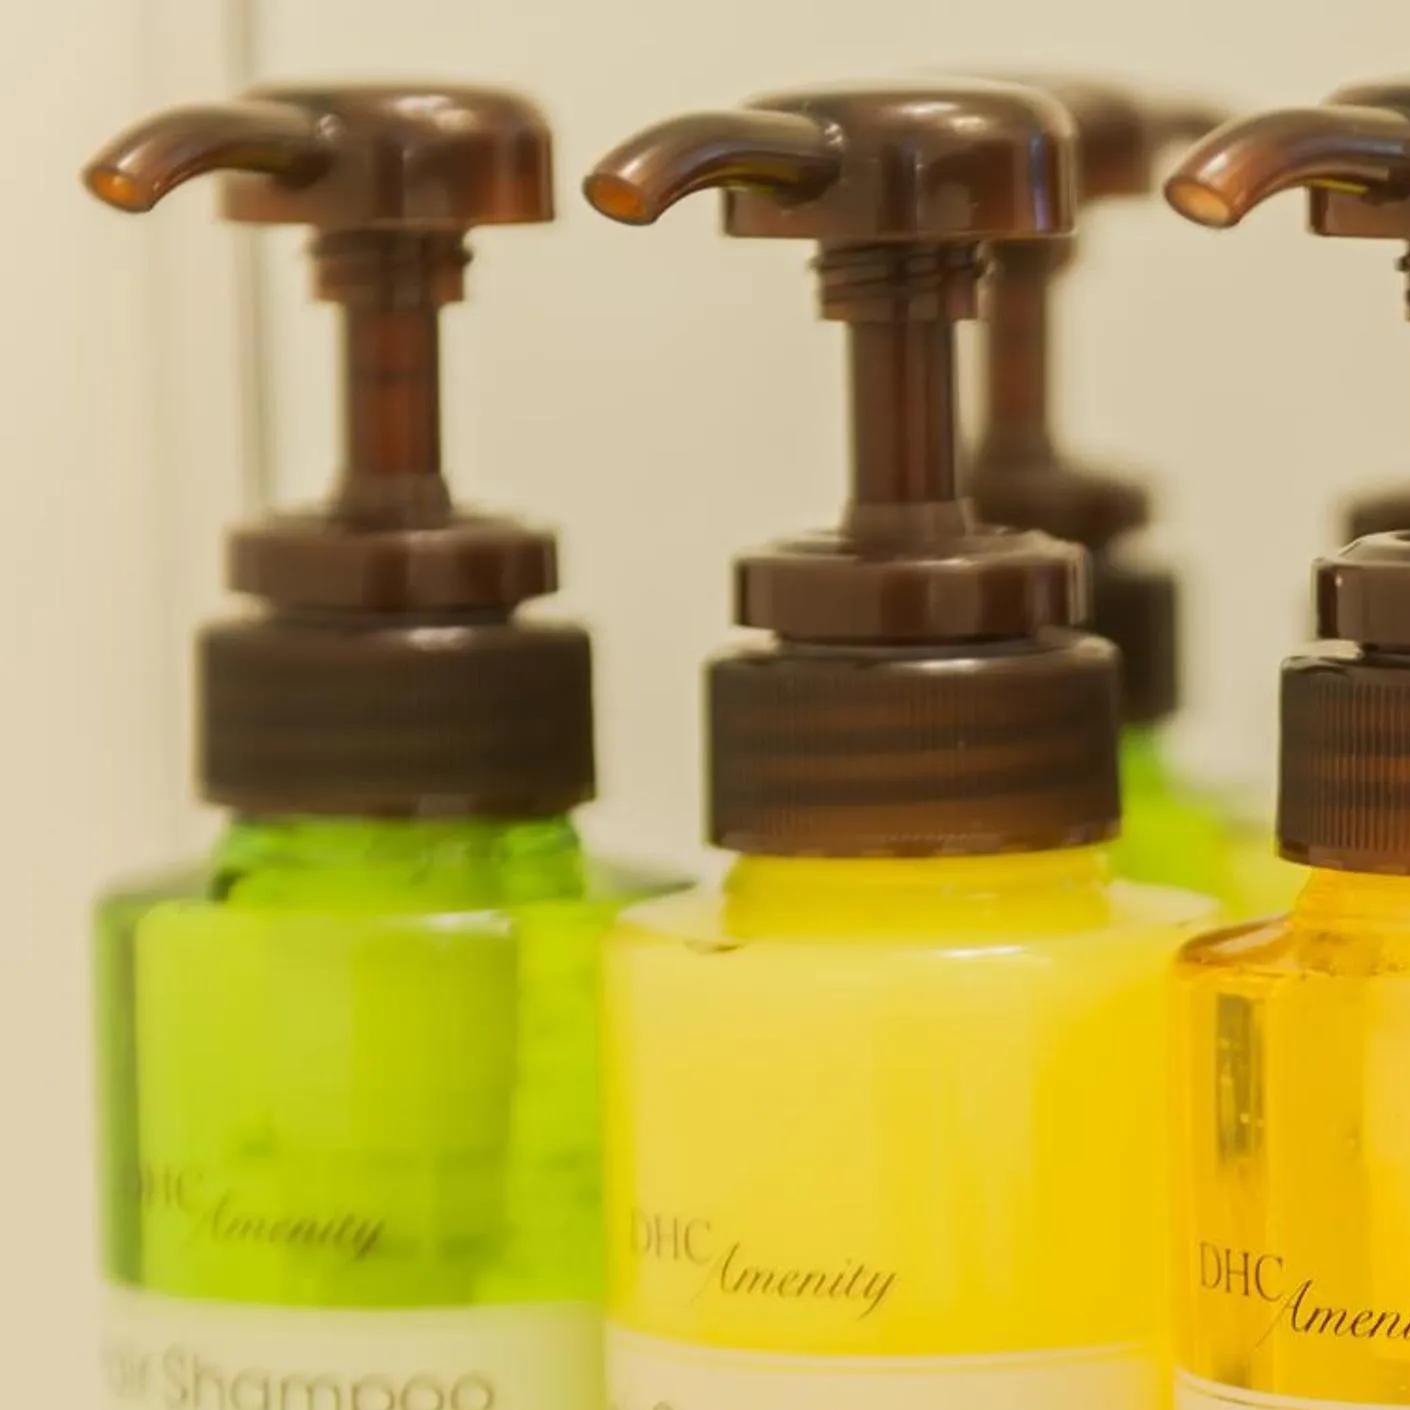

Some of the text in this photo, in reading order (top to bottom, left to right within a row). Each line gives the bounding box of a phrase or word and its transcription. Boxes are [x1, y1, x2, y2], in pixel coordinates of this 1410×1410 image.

[178, 1187, 387, 1262] Amenity
[629, 1207, 899, 1320] DHC Amenity
[1200, 1241, 1284, 1301] DHC
